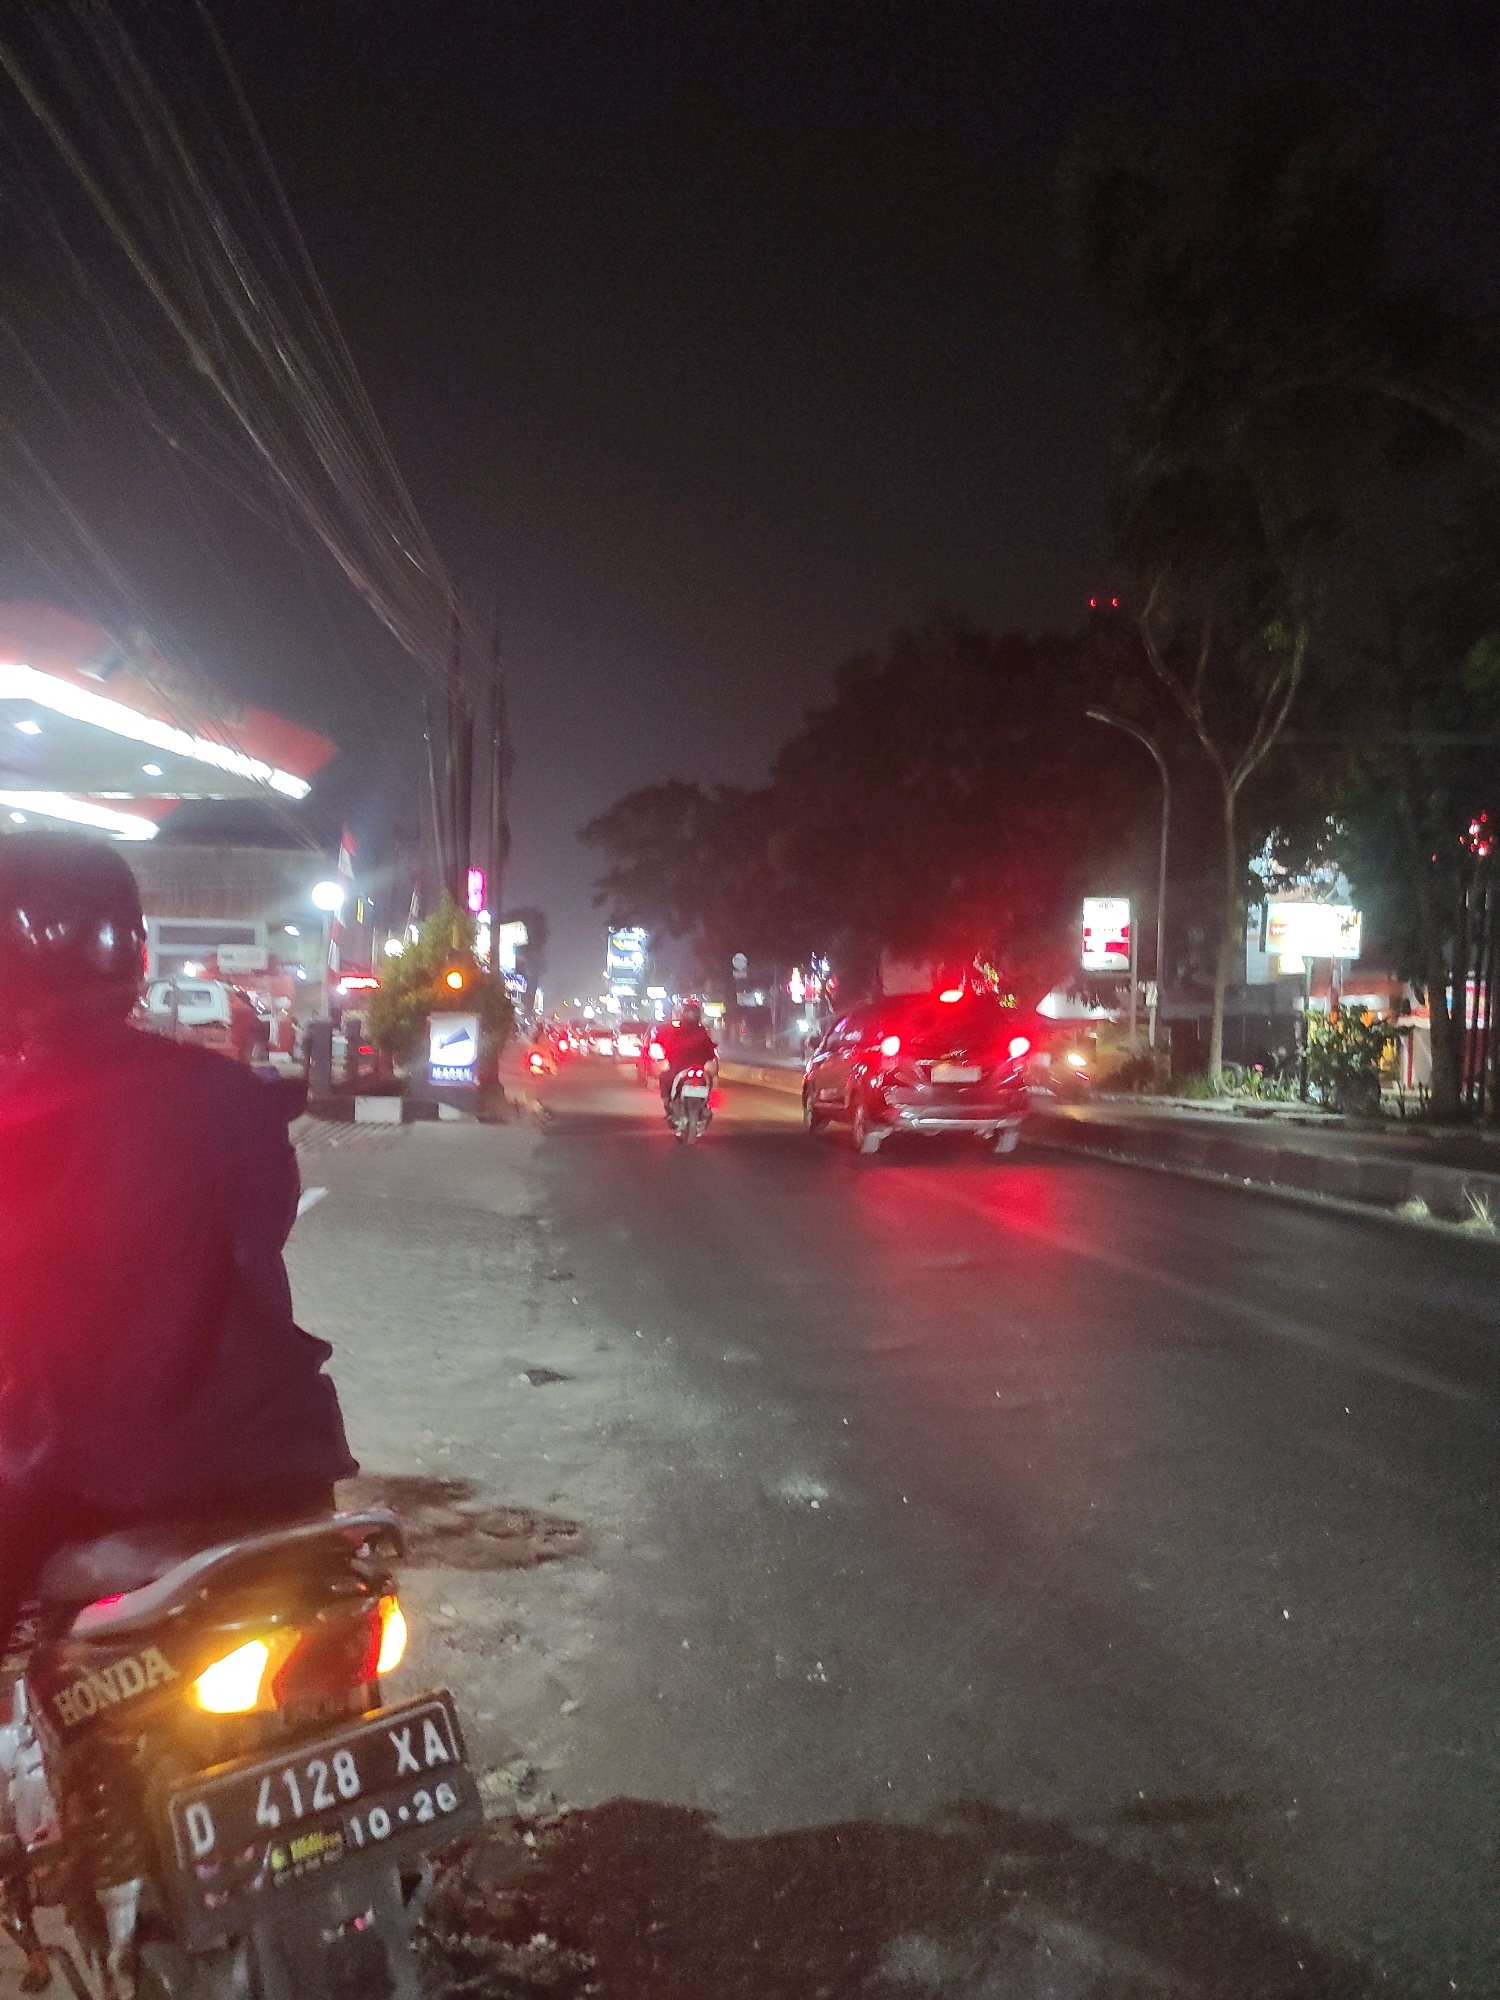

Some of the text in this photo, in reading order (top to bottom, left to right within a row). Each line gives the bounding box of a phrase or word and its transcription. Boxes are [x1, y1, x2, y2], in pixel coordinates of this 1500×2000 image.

[52, 1646, 179, 1726] HONDA
[185, 1718, 448, 1857] D 4128 XA
